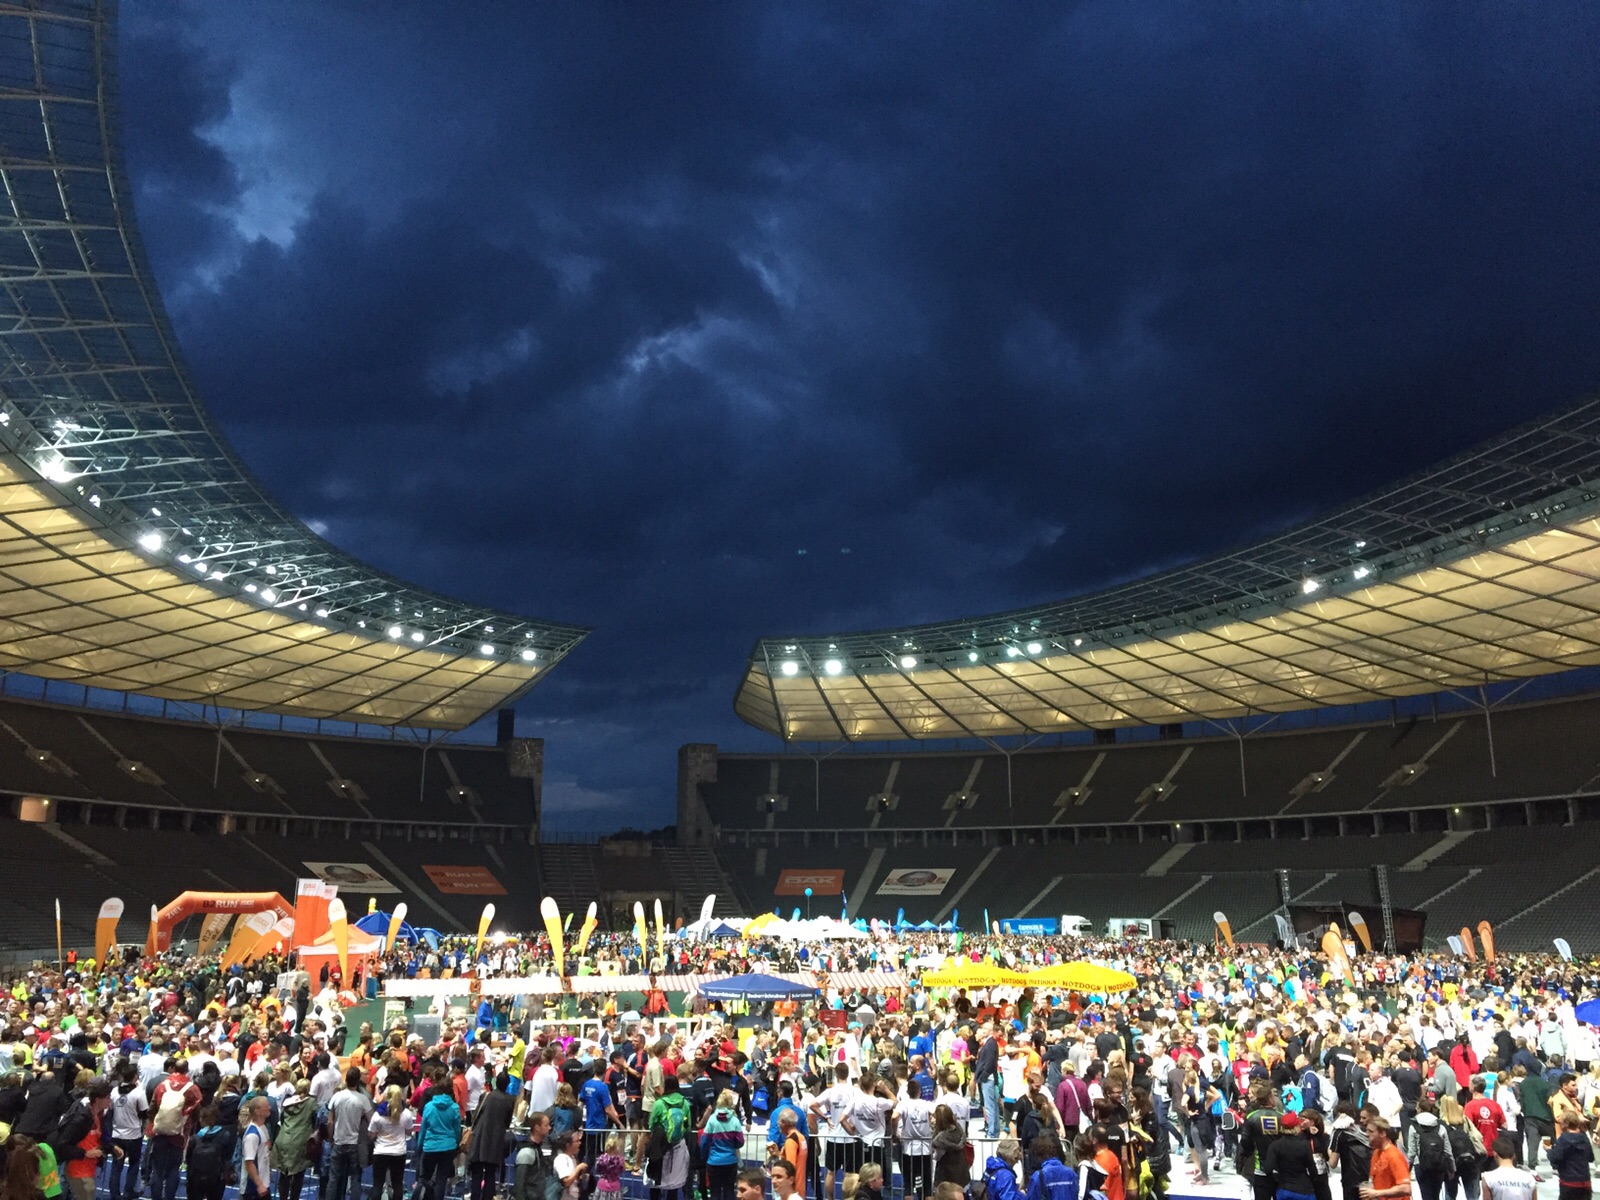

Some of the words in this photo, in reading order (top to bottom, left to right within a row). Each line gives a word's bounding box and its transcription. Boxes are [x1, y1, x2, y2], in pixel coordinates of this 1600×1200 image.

[203, 900, 238, 908] B2RUN
[1001, 977, 1027, 985] HOTDOGS
[1062, 980, 1101, 991] HOTDOGS
[1108, 981, 1134, 991] HOTDOGS
[1497, 1180, 1531, 1189] SIEMENS
